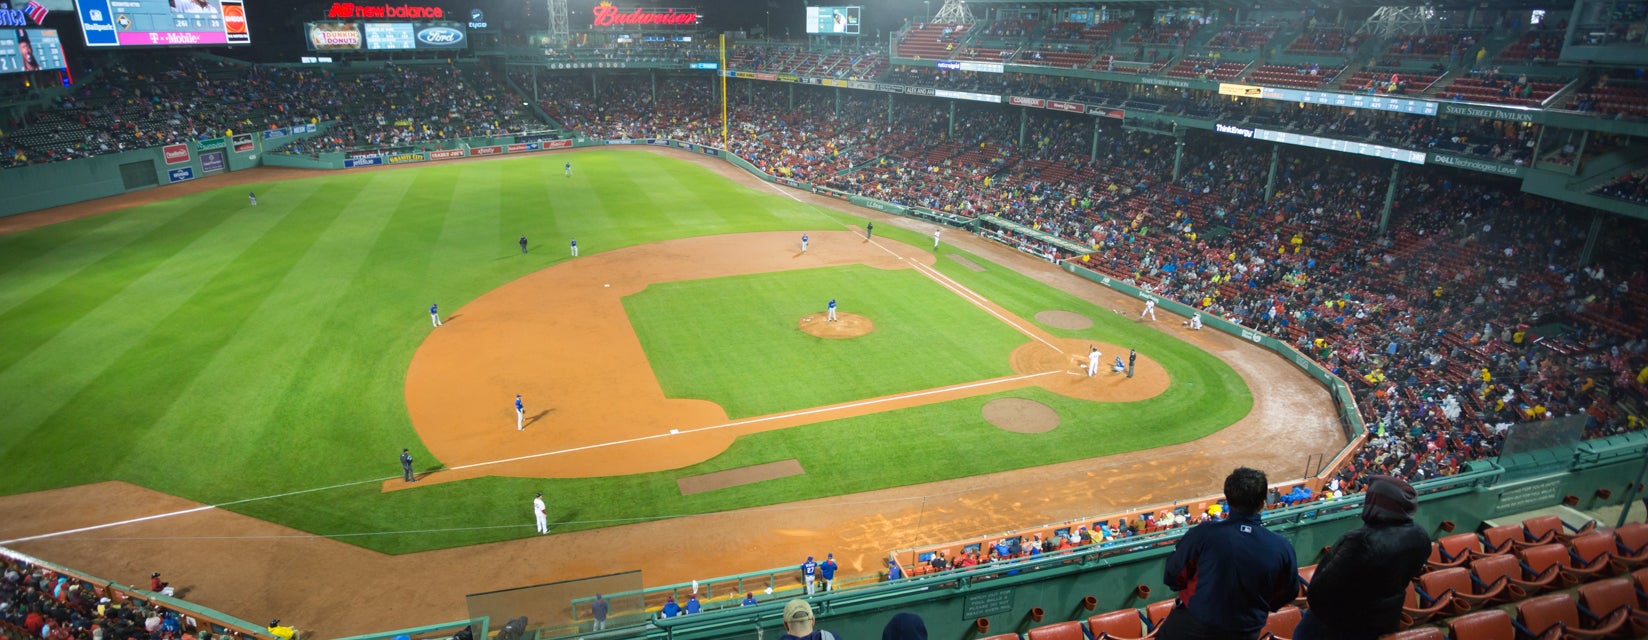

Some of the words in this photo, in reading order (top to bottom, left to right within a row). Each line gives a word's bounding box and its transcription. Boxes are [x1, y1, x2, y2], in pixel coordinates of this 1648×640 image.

[0, 2, 27, 26] rica
[355, 6, 386, 18] new
[386, 4, 443, 18] balance
[592, 6, 697, 26] Budweiser
[84, 23, 114, 32] Ballpark
[427, 30, 455, 42] Ford
[1, 57, 8, 71] 2
[1446, 105, 1466, 114] STATE
[1467, 107, 1493, 118] STREET
[1495, 110, 1533, 121] PAVILION
[1216, 123, 1254, 138] ThinkEnergy
[1435, 155, 1454, 165] DELL
[1454, 158, 1497, 172] Technologies
[1498, 164, 1517, 175] Level
